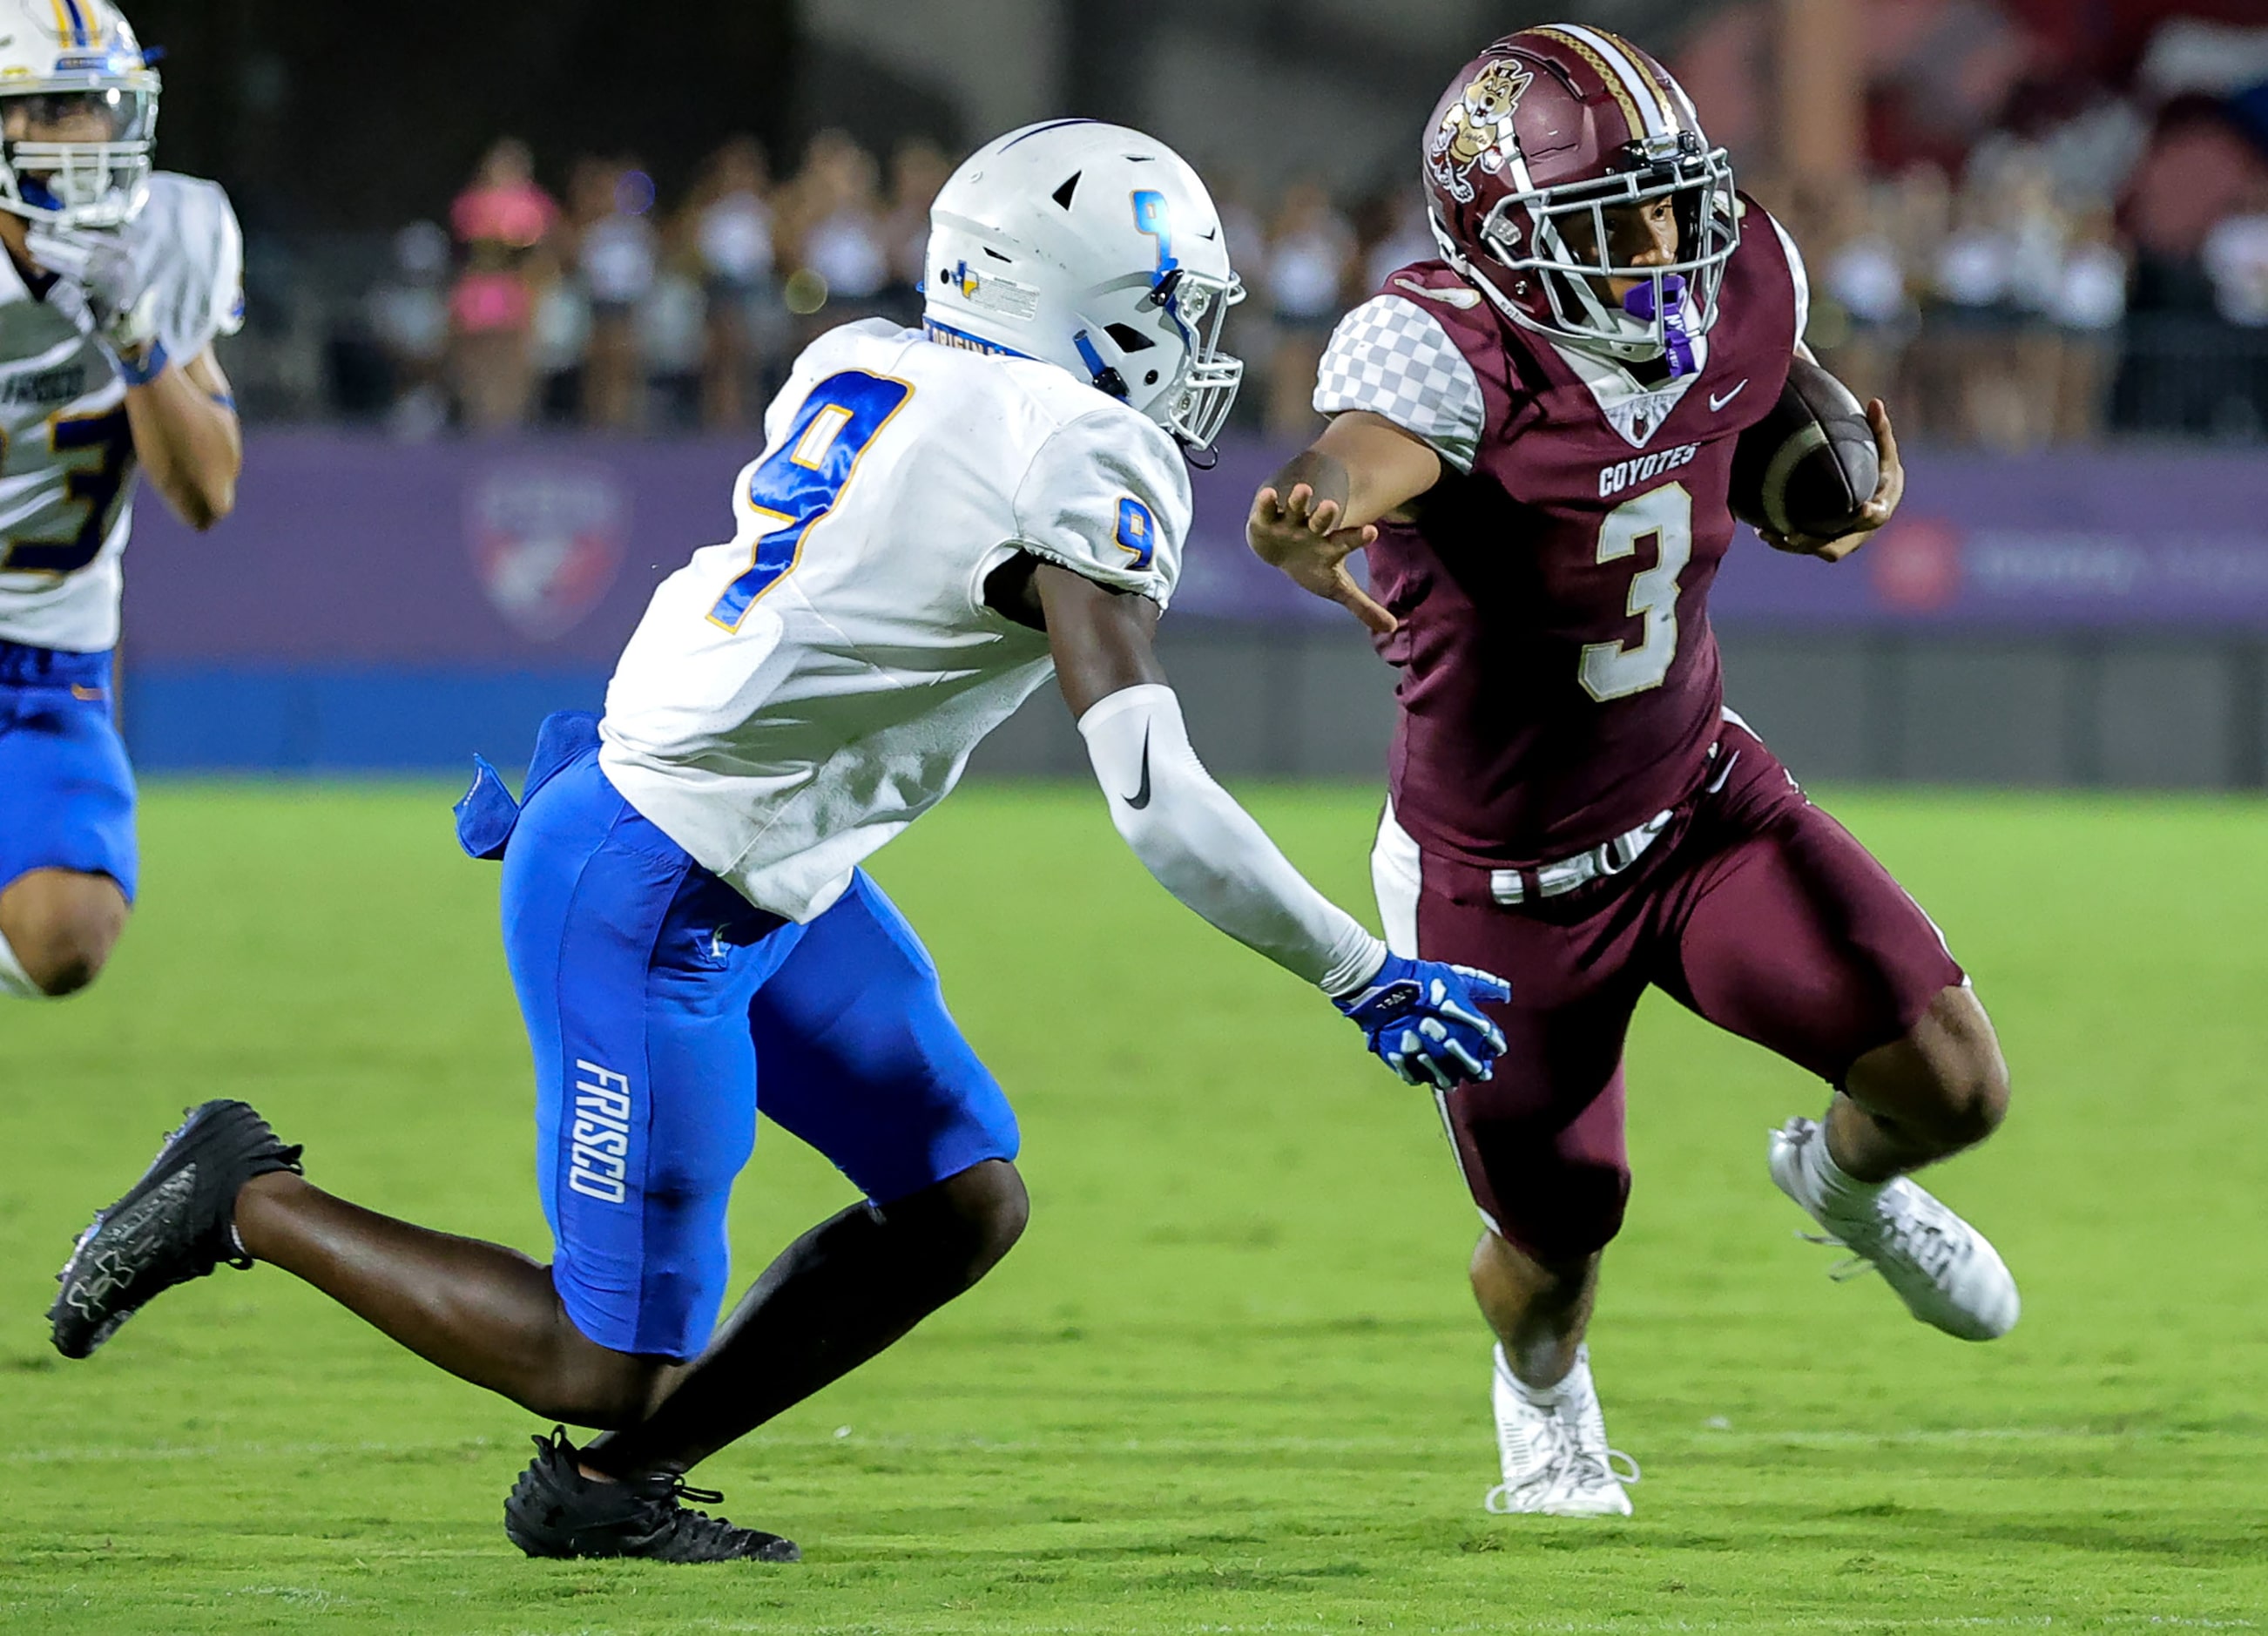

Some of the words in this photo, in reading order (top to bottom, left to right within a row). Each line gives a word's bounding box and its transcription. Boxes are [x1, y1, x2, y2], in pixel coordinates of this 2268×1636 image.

[1129, 189, 1171, 273] 9
[0, 413, 137, 578] 3
[705, 367, 916, 636] 9
[1112, 495, 1155, 572] 9
[1598, 442, 1701, 497] COYOTES
[1578, 480, 1692, 702] 3
[570, 1058, 631, 1204] FRISCO
